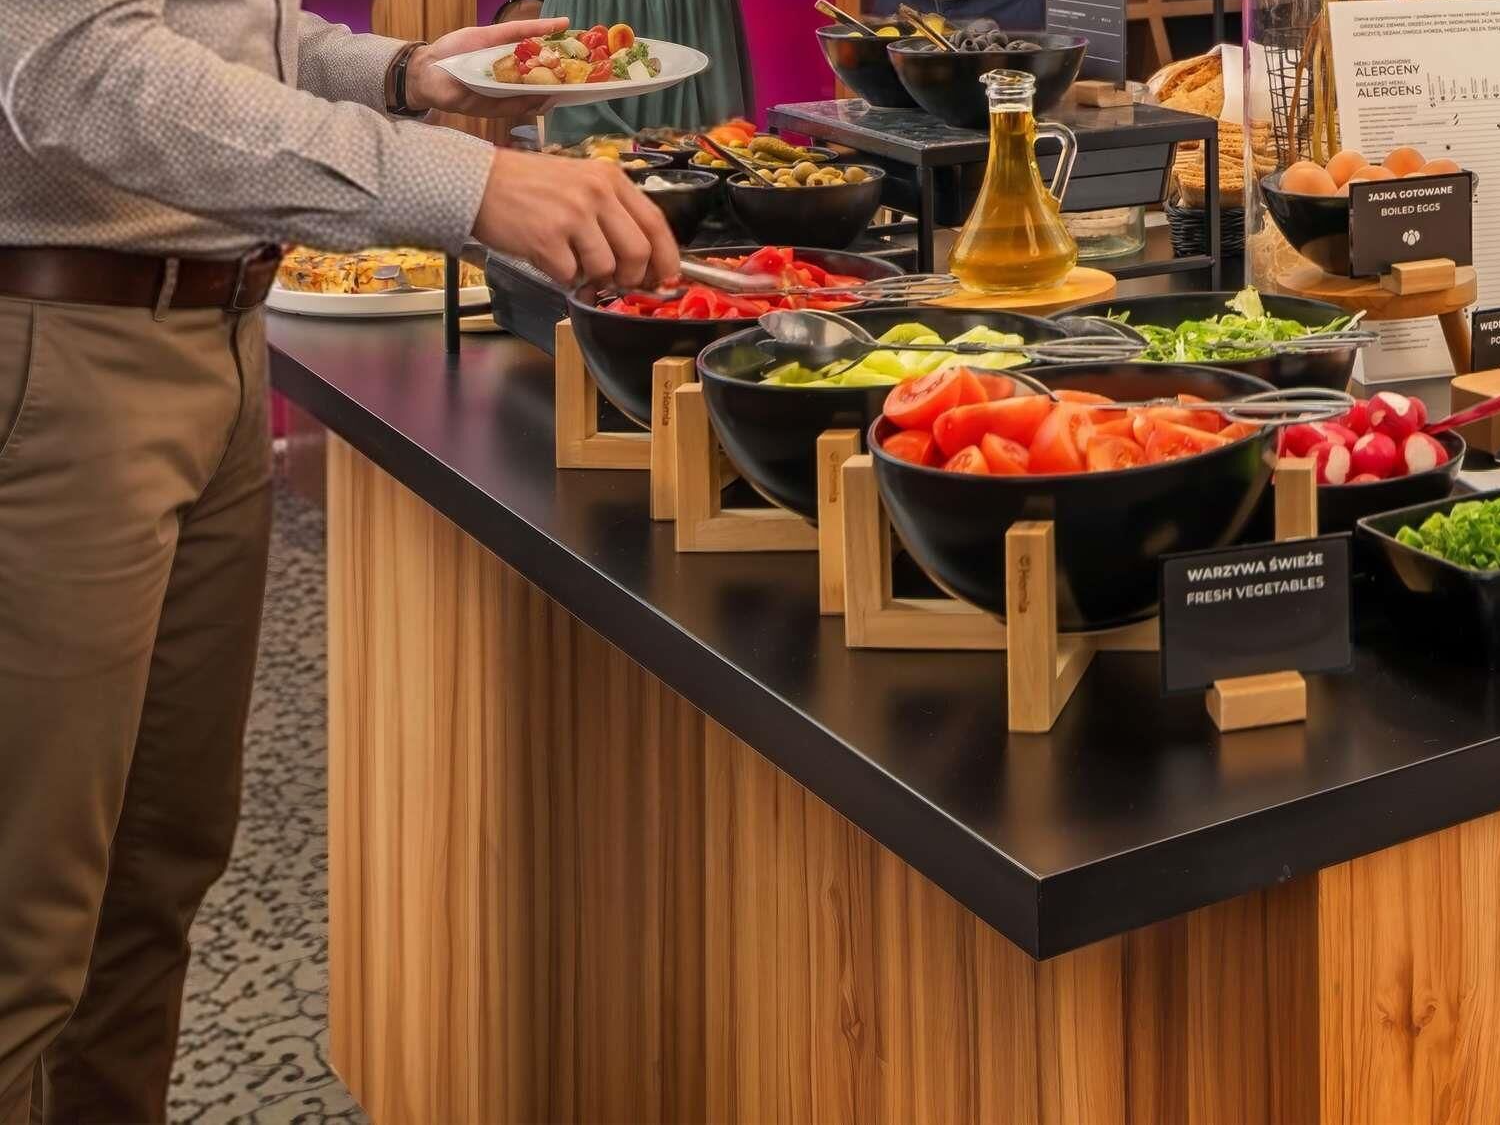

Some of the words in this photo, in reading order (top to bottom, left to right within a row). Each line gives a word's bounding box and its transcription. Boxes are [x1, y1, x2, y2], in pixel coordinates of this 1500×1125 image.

[1355, 65, 1420, 76] ALERGENY
[1357, 85, 1422, 98] ALERGENS
[1368, 191, 1397, 202] JAJKA
[1399, 186, 1454, 199] GOTOWANE
[1381, 205, 1415, 217] BOILED
[1416, 202, 1441, 213] EGGS
[1187, 560, 1266, 582] WARZYWA
[1269, 551, 1324, 572] ŚWIEŻE
[1186, 587, 1232, 605] FRESH
[1235, 575, 1325, 600] VEGETABLES
